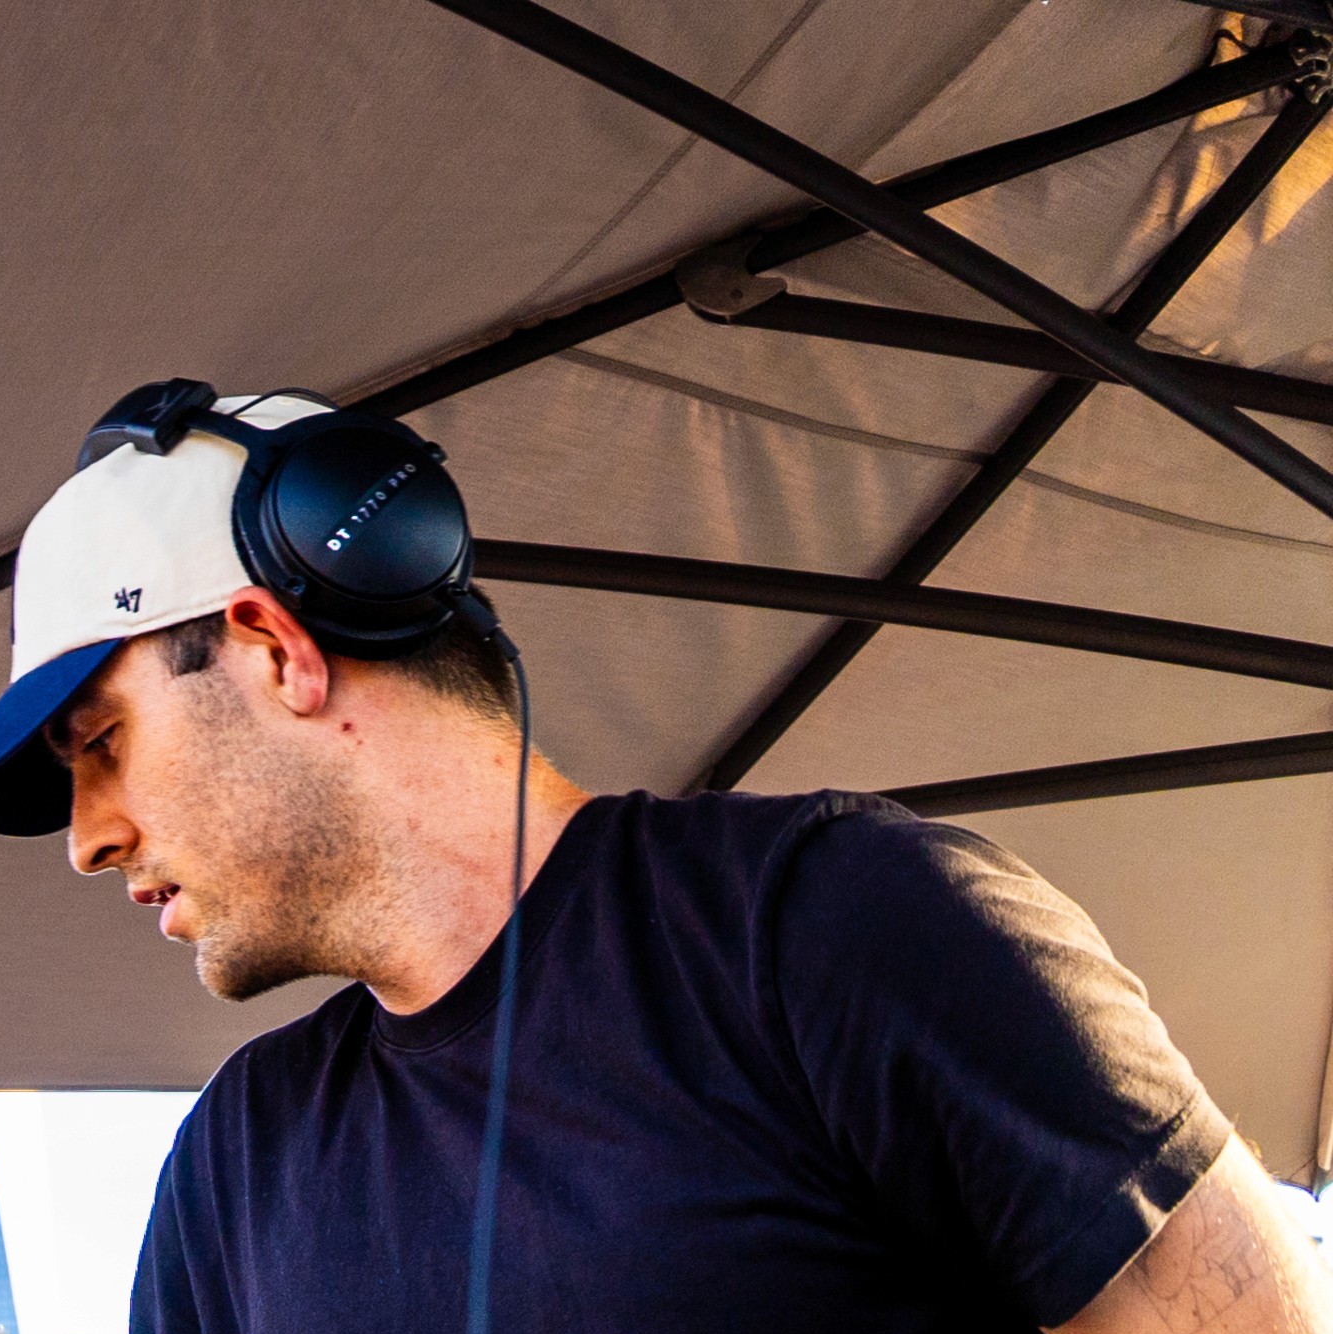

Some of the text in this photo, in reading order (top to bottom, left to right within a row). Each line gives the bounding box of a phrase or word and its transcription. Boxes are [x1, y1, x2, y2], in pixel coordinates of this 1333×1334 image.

[326, 463, 417, 551] DT 1770 PRO
